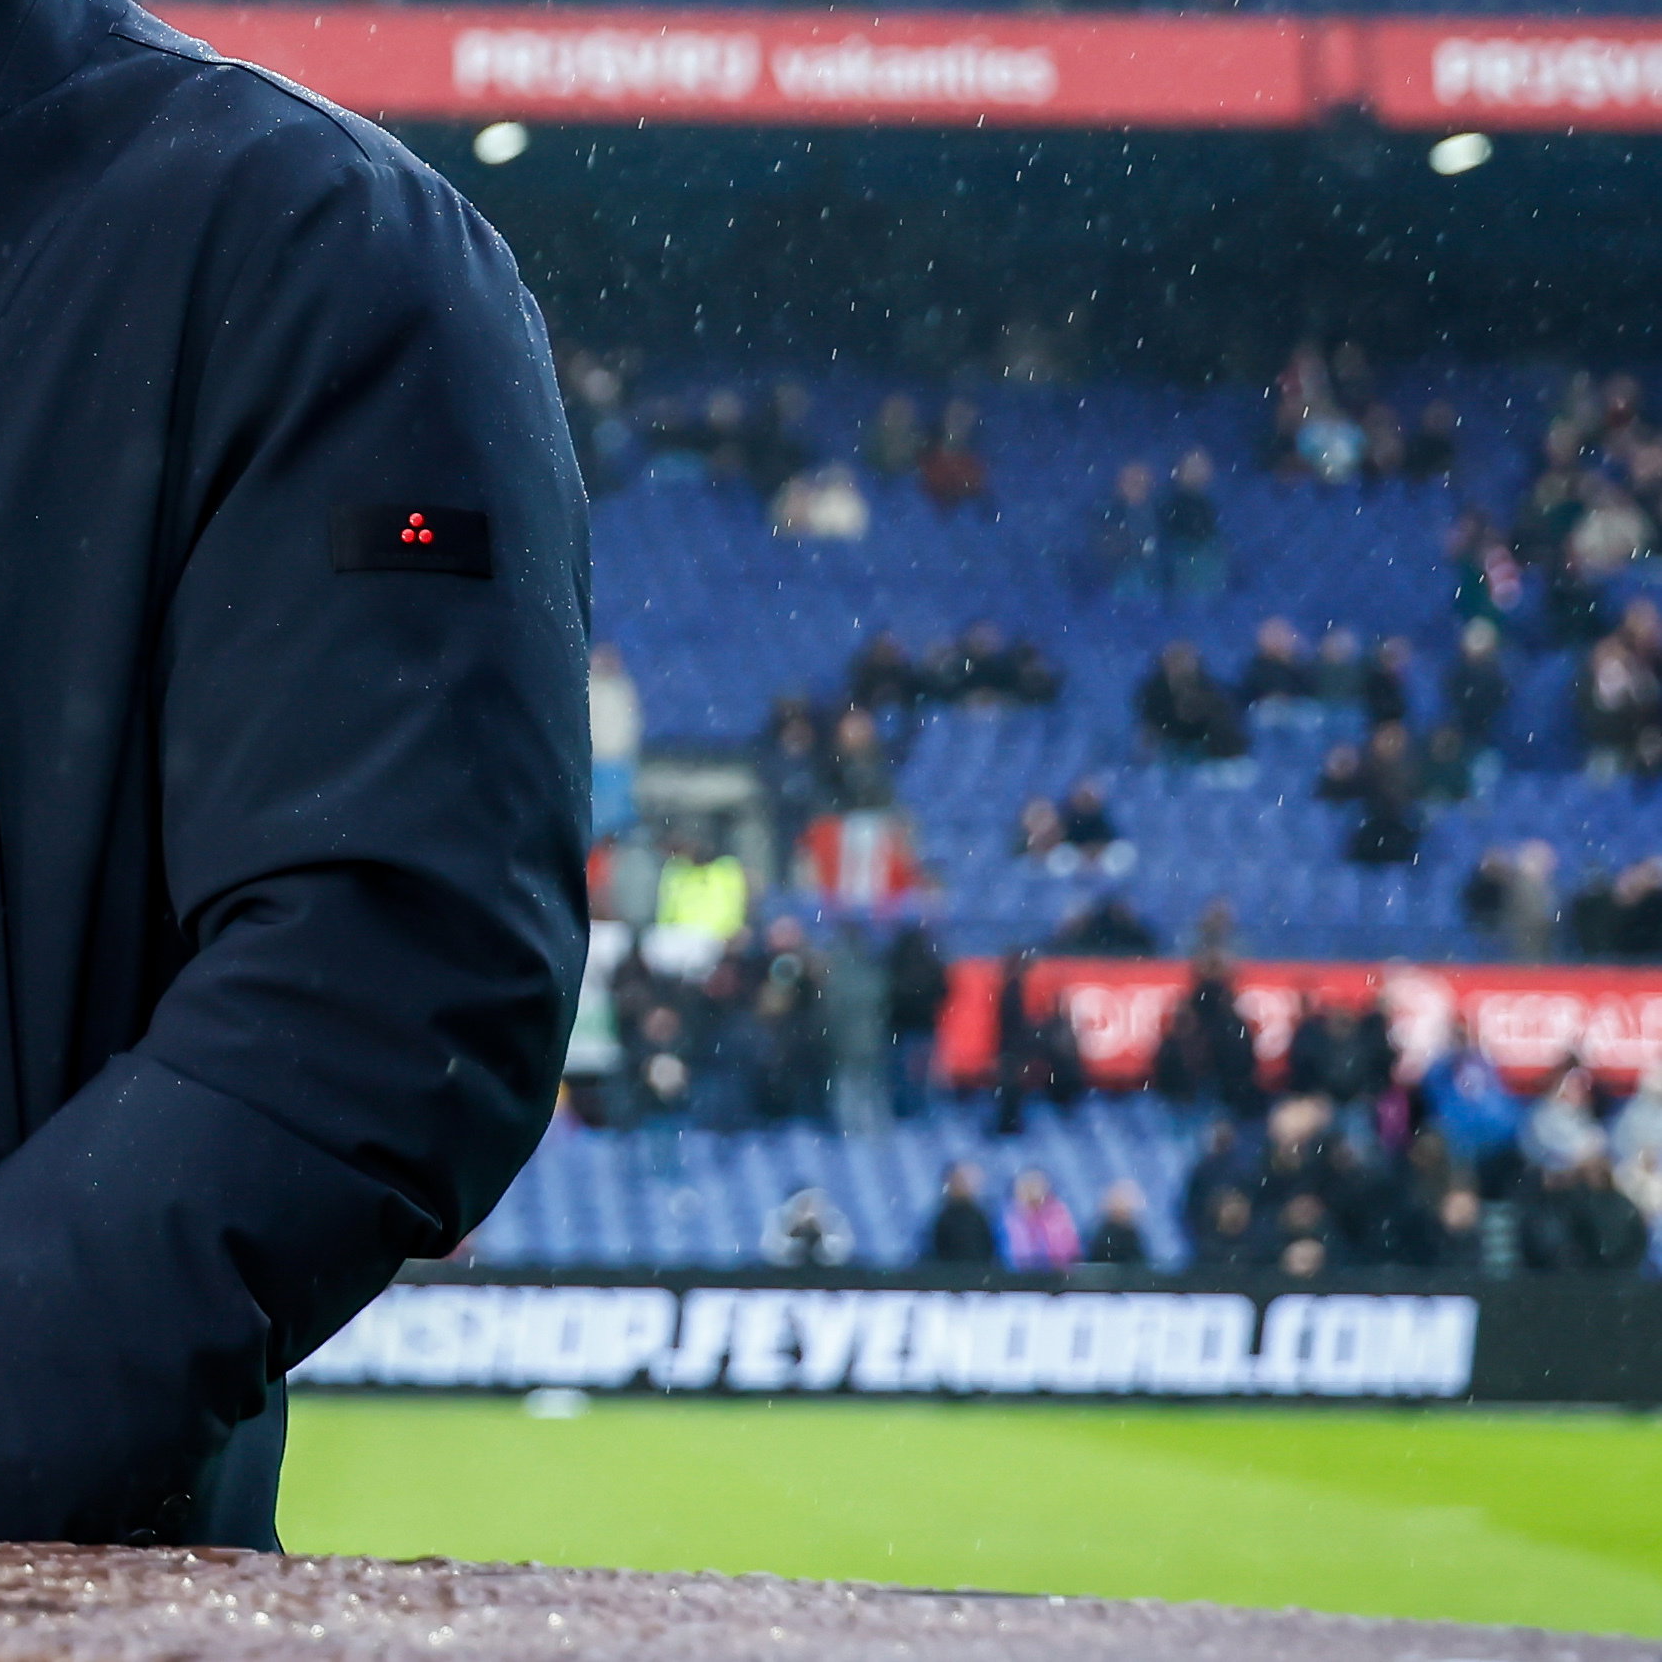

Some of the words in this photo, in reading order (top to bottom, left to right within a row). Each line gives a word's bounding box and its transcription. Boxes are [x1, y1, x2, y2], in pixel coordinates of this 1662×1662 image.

[772, 32, 1057, 107] vakanties
[1433, 32, 1662, 109] PRIJSV
[296, 1285, 1476, 1394] NSHOP.FEYENOORD.COM
